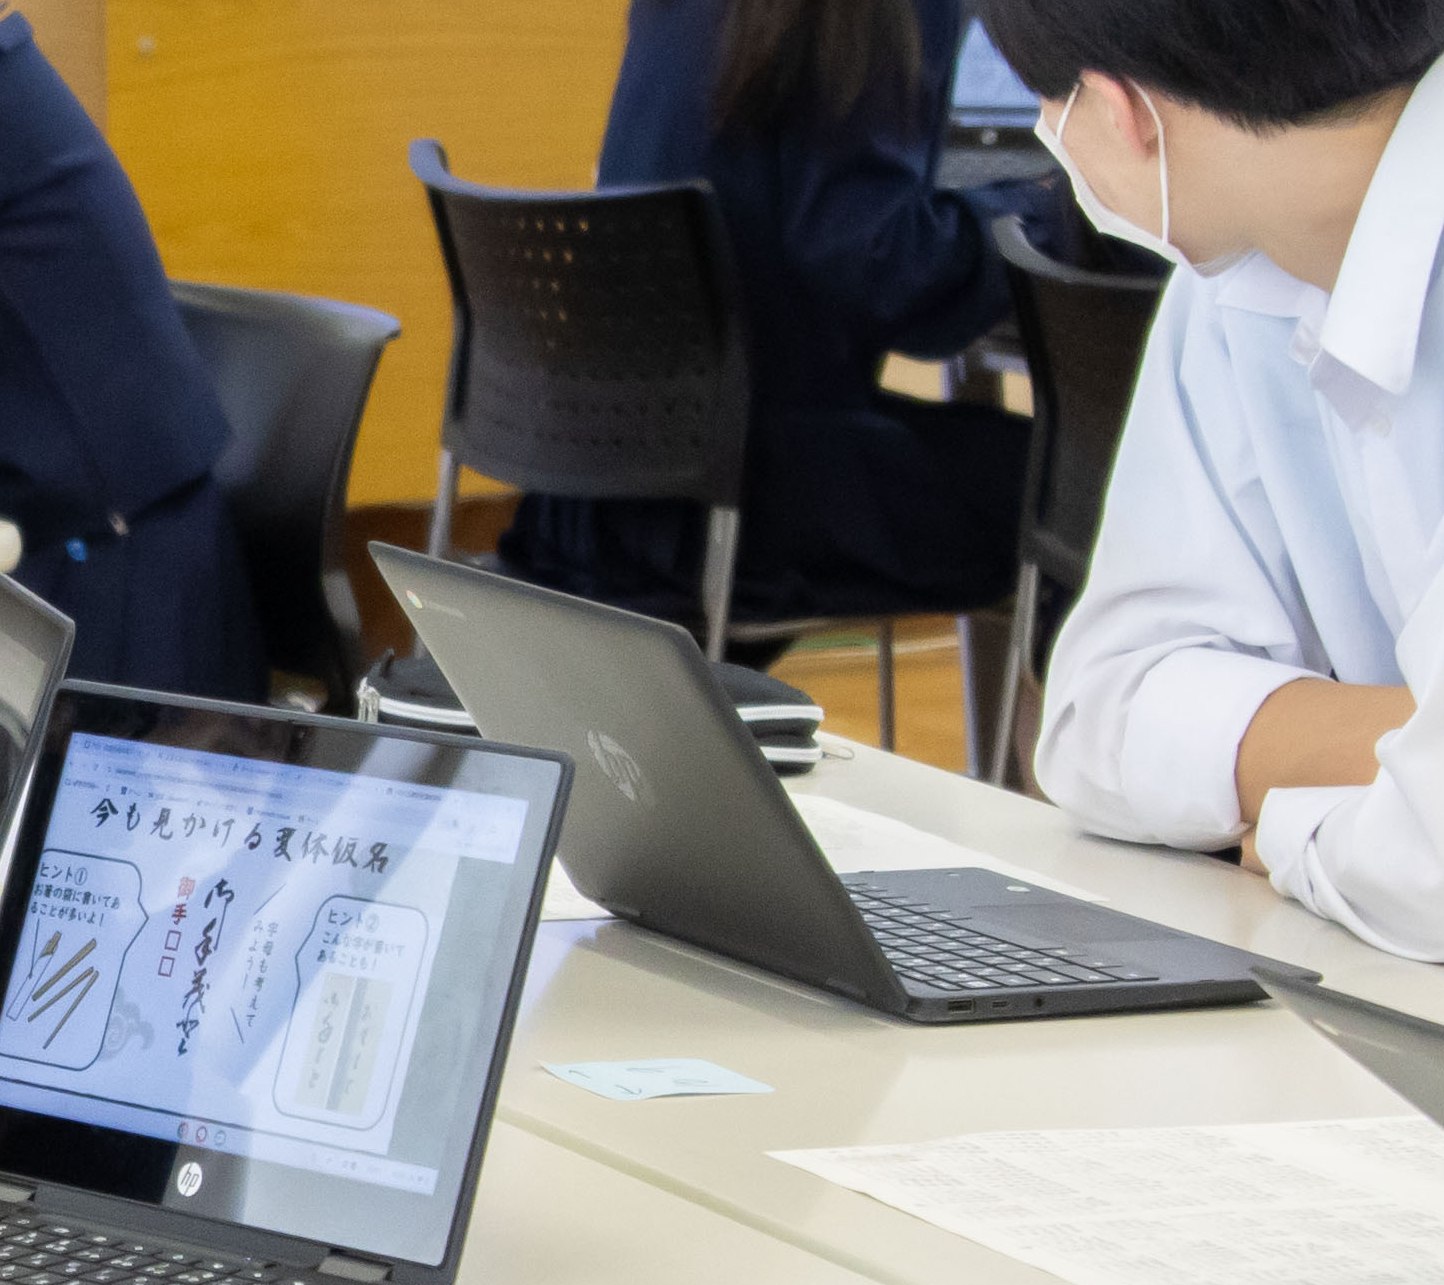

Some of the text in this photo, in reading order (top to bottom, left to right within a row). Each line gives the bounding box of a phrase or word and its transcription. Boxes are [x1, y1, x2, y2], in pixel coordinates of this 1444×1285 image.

[89, 797, 390, 874] 今も見かける変体仮名
[178, 1163, 202, 1196] hp
